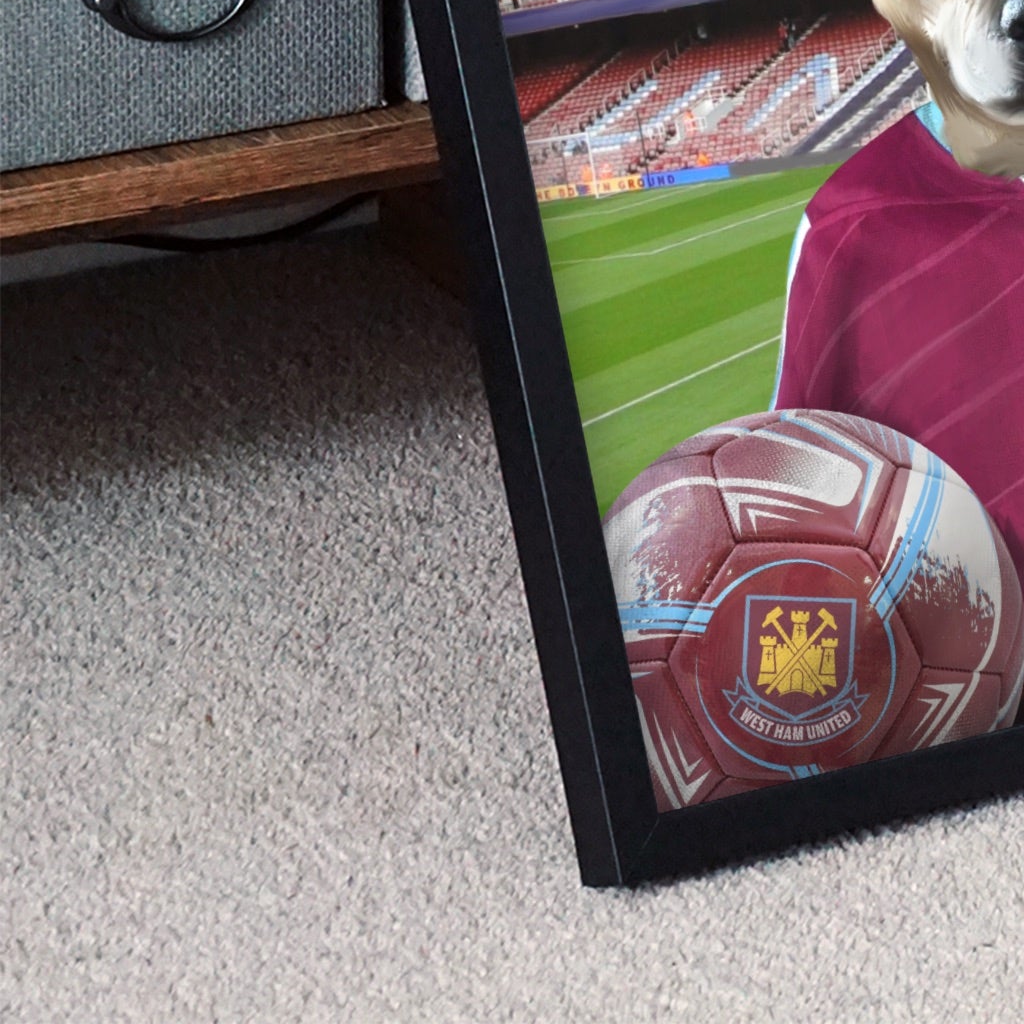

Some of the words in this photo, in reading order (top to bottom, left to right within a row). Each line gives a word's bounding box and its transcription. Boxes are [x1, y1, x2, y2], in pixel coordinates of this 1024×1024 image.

[617, 175, 676, 192] GROUND
[740, 707, 775, 735] WEST
[773, 724, 804, 741] HAM
[806, 709, 852, 739] UNITED
